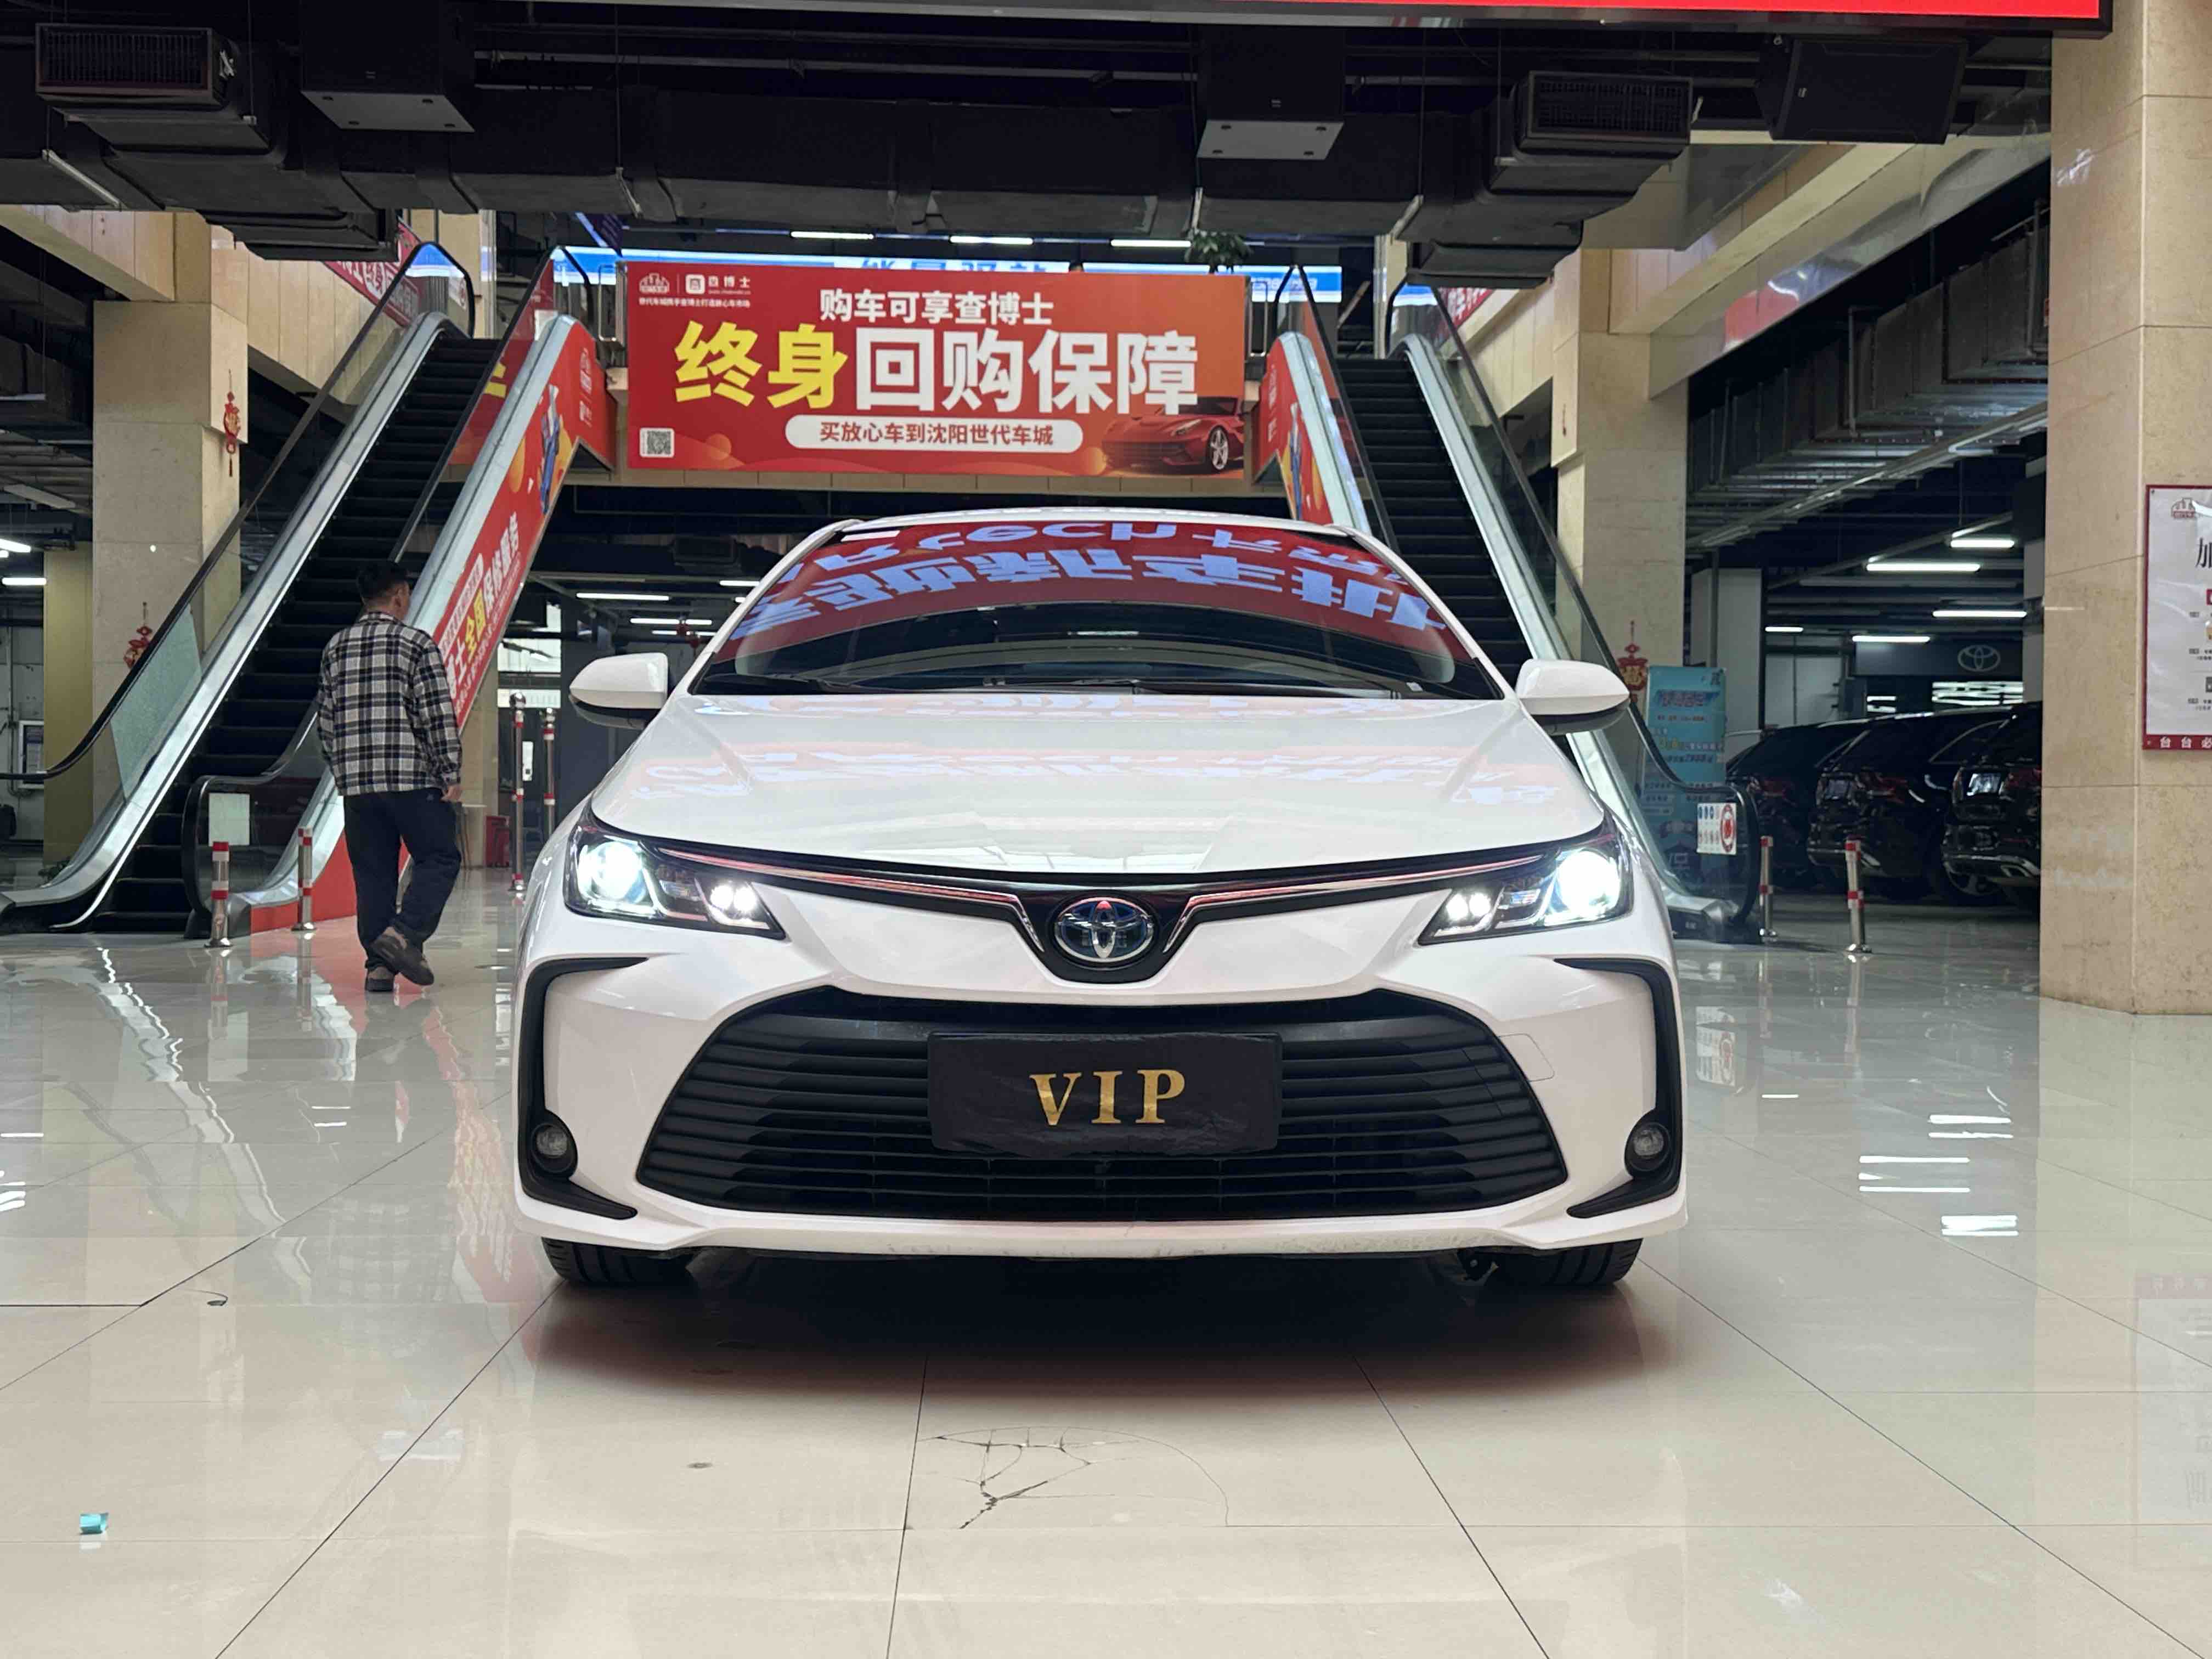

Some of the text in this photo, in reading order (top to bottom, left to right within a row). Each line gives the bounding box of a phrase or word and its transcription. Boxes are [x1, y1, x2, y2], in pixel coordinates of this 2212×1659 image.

[820, 288, 1054, 325] 购车可享查博士
[674, 320, 1198, 415] 终身回购保障
[820, 421, 1054, 446] 买放心车到沈阳世代车城
[1029, 1069, 1186, 1126] VIP
